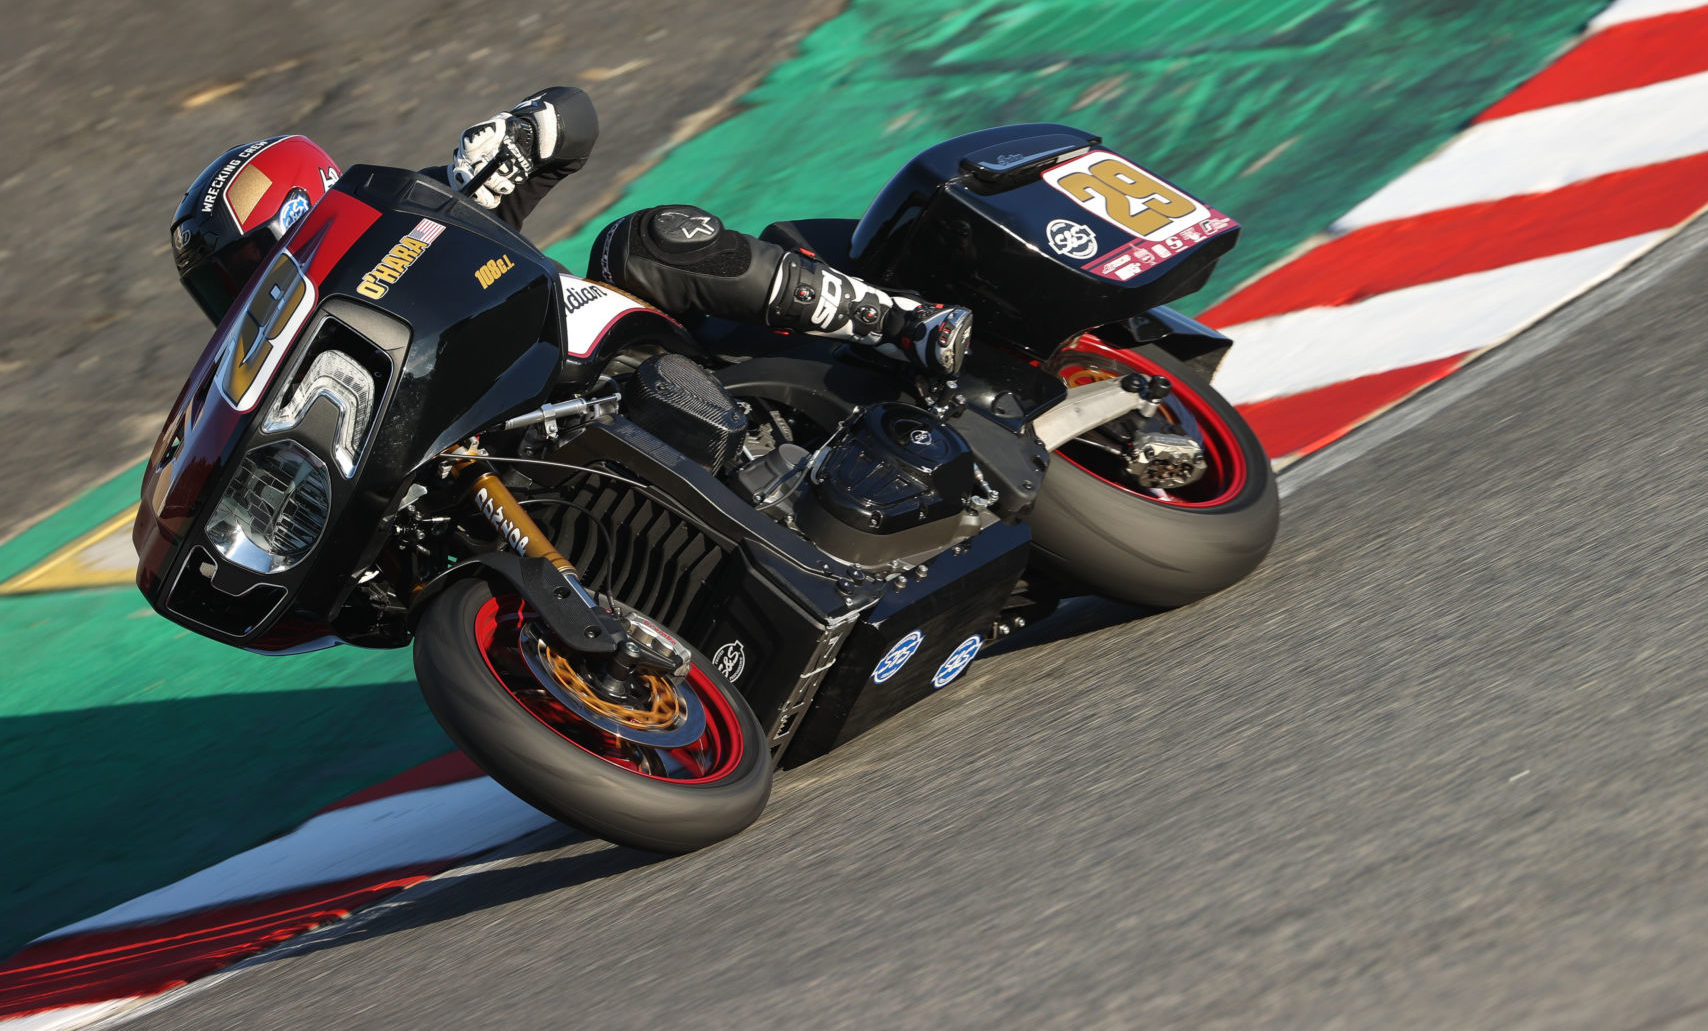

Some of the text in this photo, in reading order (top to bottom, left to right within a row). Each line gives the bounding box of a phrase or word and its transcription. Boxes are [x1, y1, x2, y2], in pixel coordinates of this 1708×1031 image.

[201, 140, 268, 213] WRECKING CREW
[1056, 158, 1197, 237] 29
[356, 234, 432, 301] O'HARA
[564, 284, 608, 314] dian
